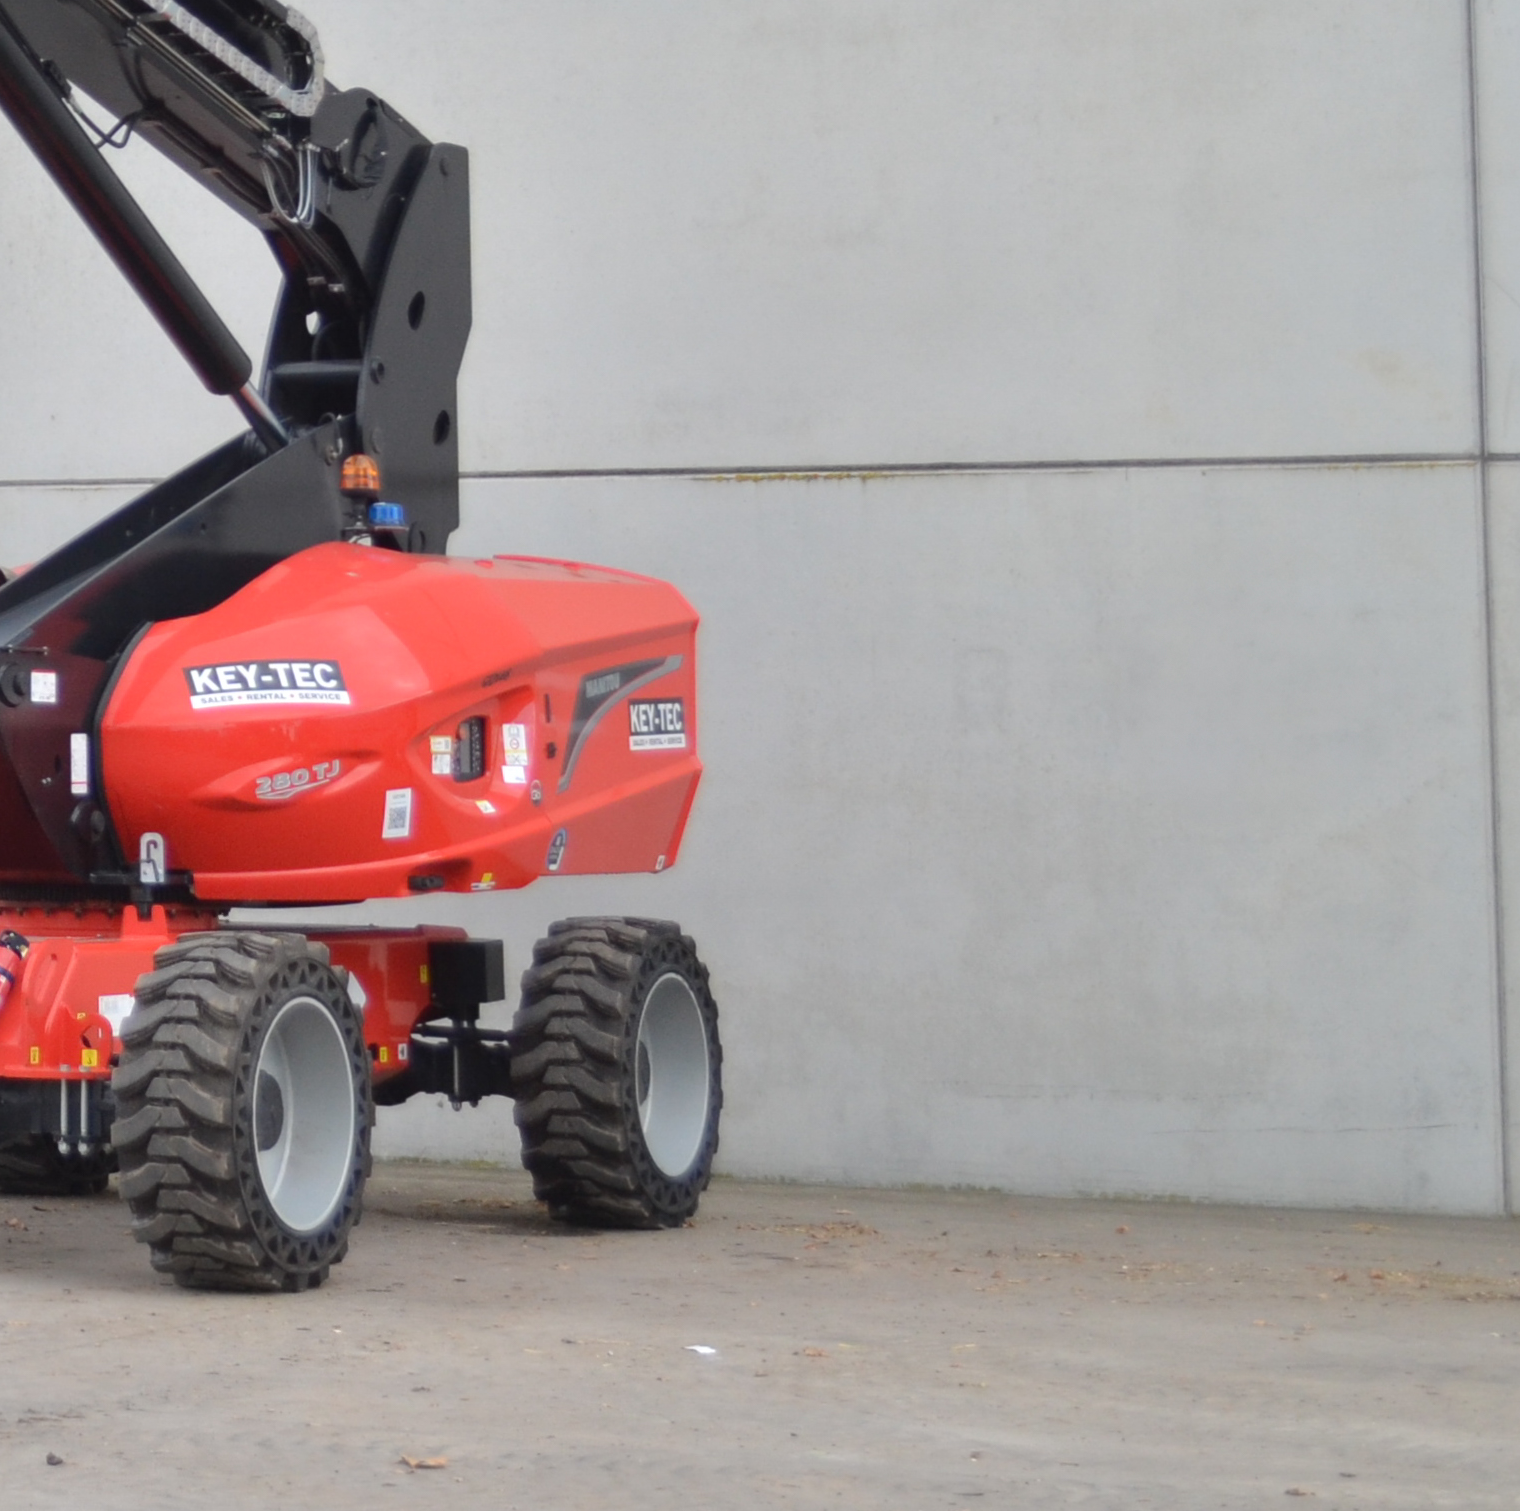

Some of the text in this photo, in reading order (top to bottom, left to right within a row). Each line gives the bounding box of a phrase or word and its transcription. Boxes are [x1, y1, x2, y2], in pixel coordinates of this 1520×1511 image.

[190, 662, 338, 693] KEY-TEC
[200, 692, 341, 704] SALES RENTAL SERVICE
[630, 702, 683, 733] KEY-TEC
[255, 758, 340, 794] 280 TJ
